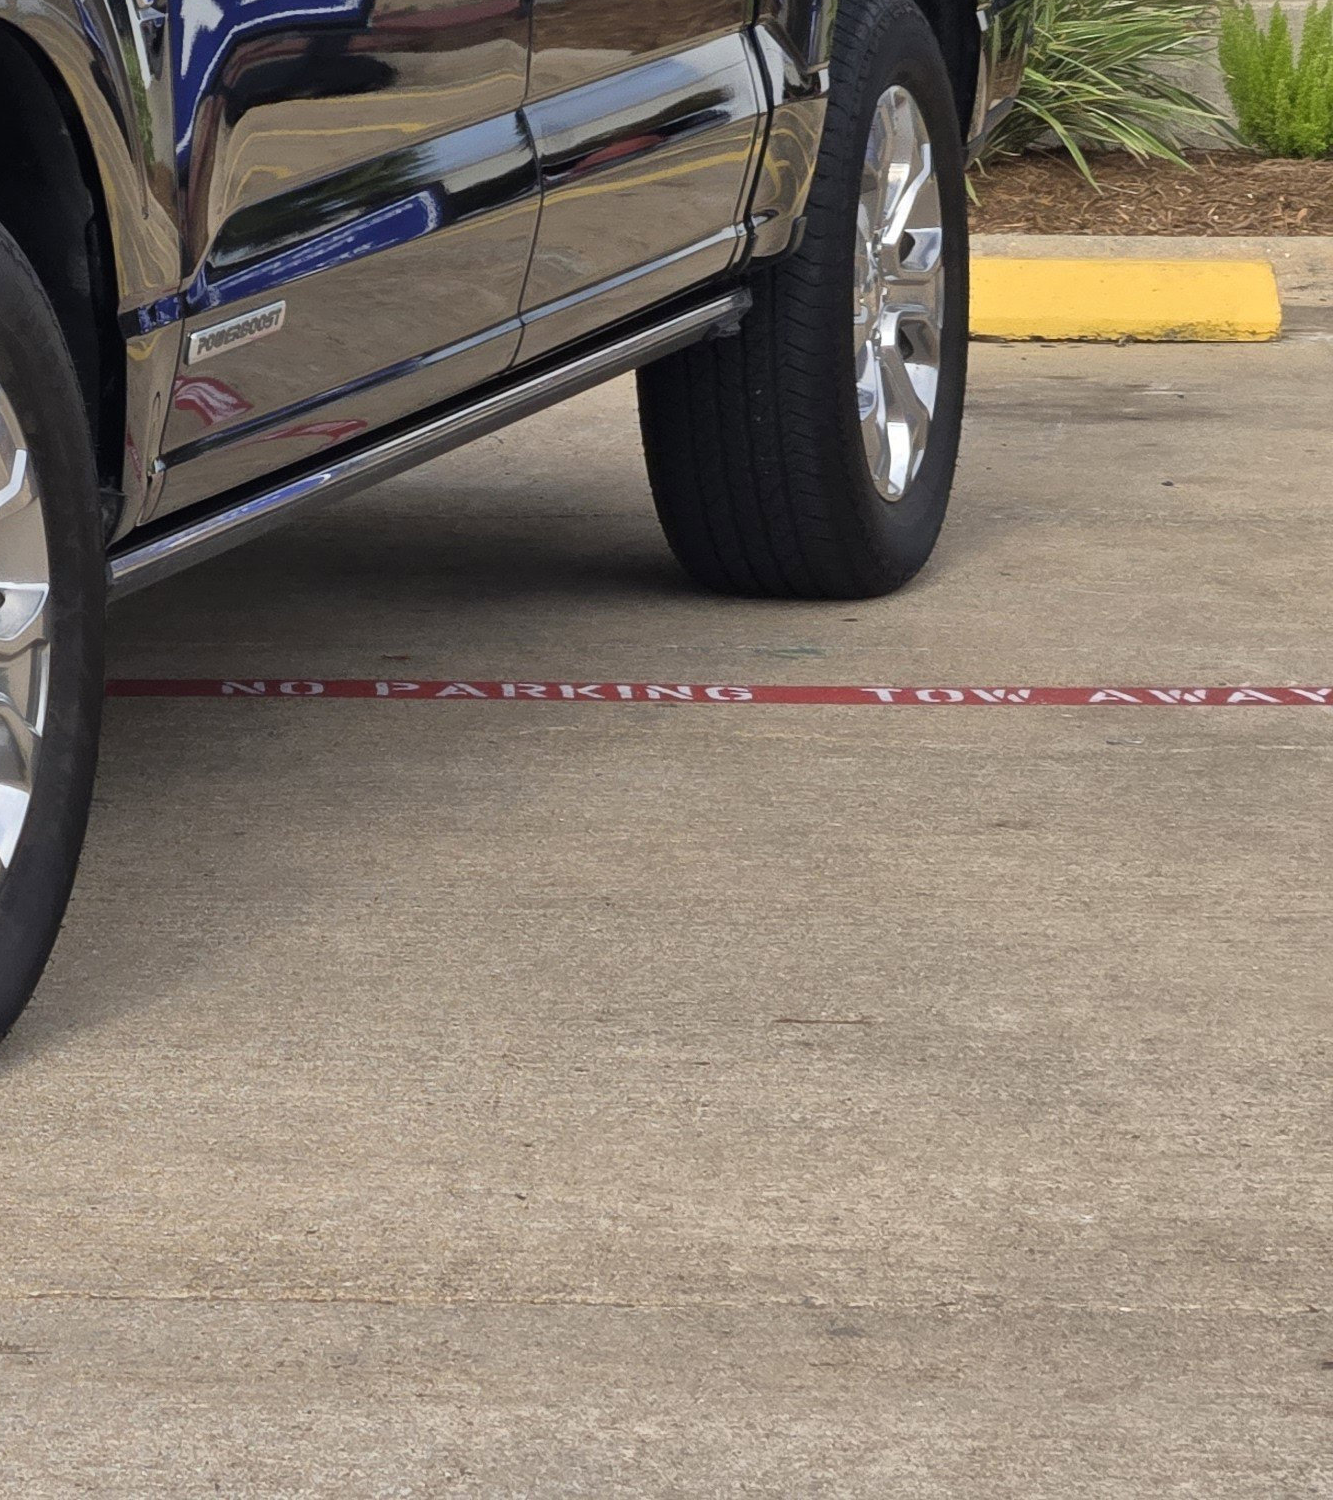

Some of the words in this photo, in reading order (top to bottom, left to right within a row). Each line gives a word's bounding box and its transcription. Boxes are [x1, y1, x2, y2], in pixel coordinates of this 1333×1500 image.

[196, 307, 282, 355] POWERBOOST
[221, 681, 325, 697] NO
[375, 681, 754, 701] PARKING
[861, 687, 1032, 704] TOW
[1087, 687, 1333, 704] AWAY
